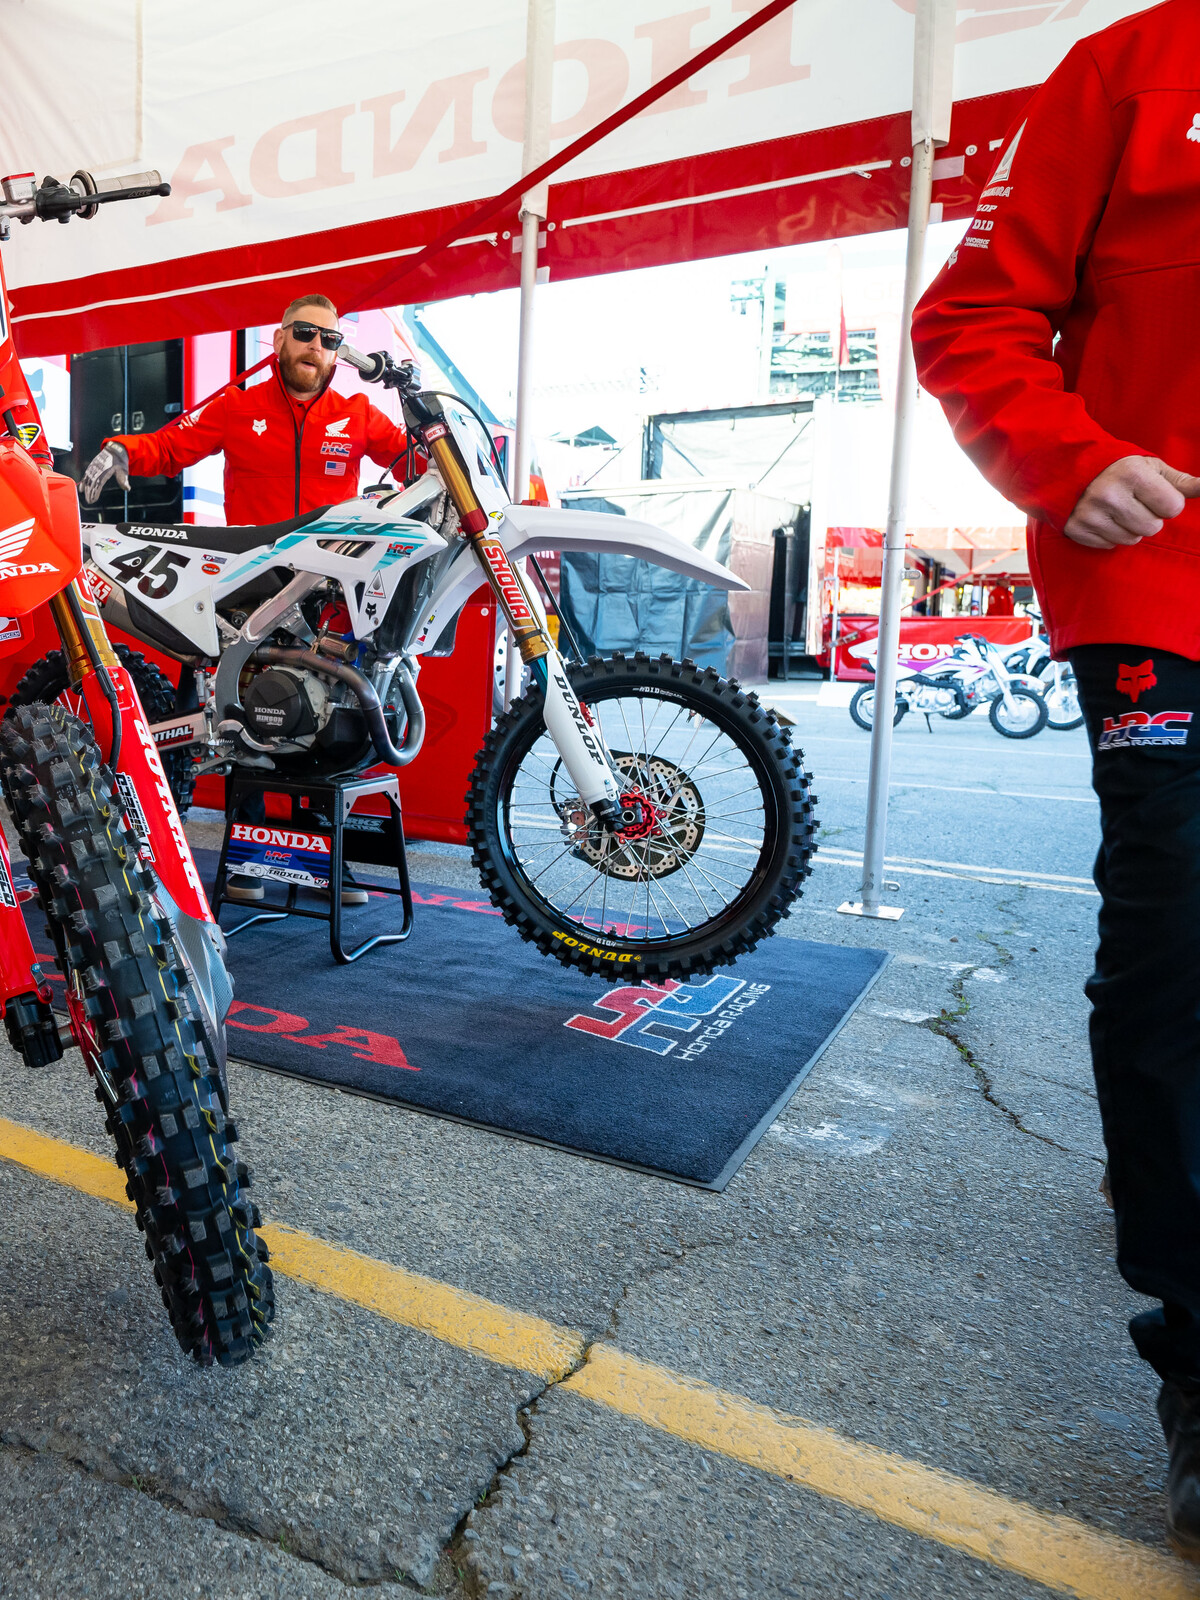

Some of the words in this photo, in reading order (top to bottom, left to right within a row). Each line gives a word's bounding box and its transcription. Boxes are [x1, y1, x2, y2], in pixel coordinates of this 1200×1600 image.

[972, 219, 994, 231] DID
[320, 441, 352, 456] HRC
[127, 526, 188, 540] HONDA
[296, 521, 423, 535] CRF
[386, 543, 414, 556] HRC
[108, 544, 191, 599] 45
[483, 545, 532, 620] SHOWA
[898, 642, 956, 660] HON
[644, 686, 660, 694] DID
[254, 707, 286, 715] HONDA
[554, 674, 604, 765] DUNLOP
[152, 725, 193, 742] NTHAL
[1100, 711, 1194, 744] HRC
[133, 719, 201, 889] DUNLOP
[232, 825, 330, 853] HONDA
[263, 850, 292, 863] HRC
[268, 868, 311, 882] TROXELL
[552, 930, 633, 962] DUNLOP
[563, 974, 747, 1056] HRC
[673, 1018, 733, 1061] Honda
[721, 982, 772, 1021] RACING
